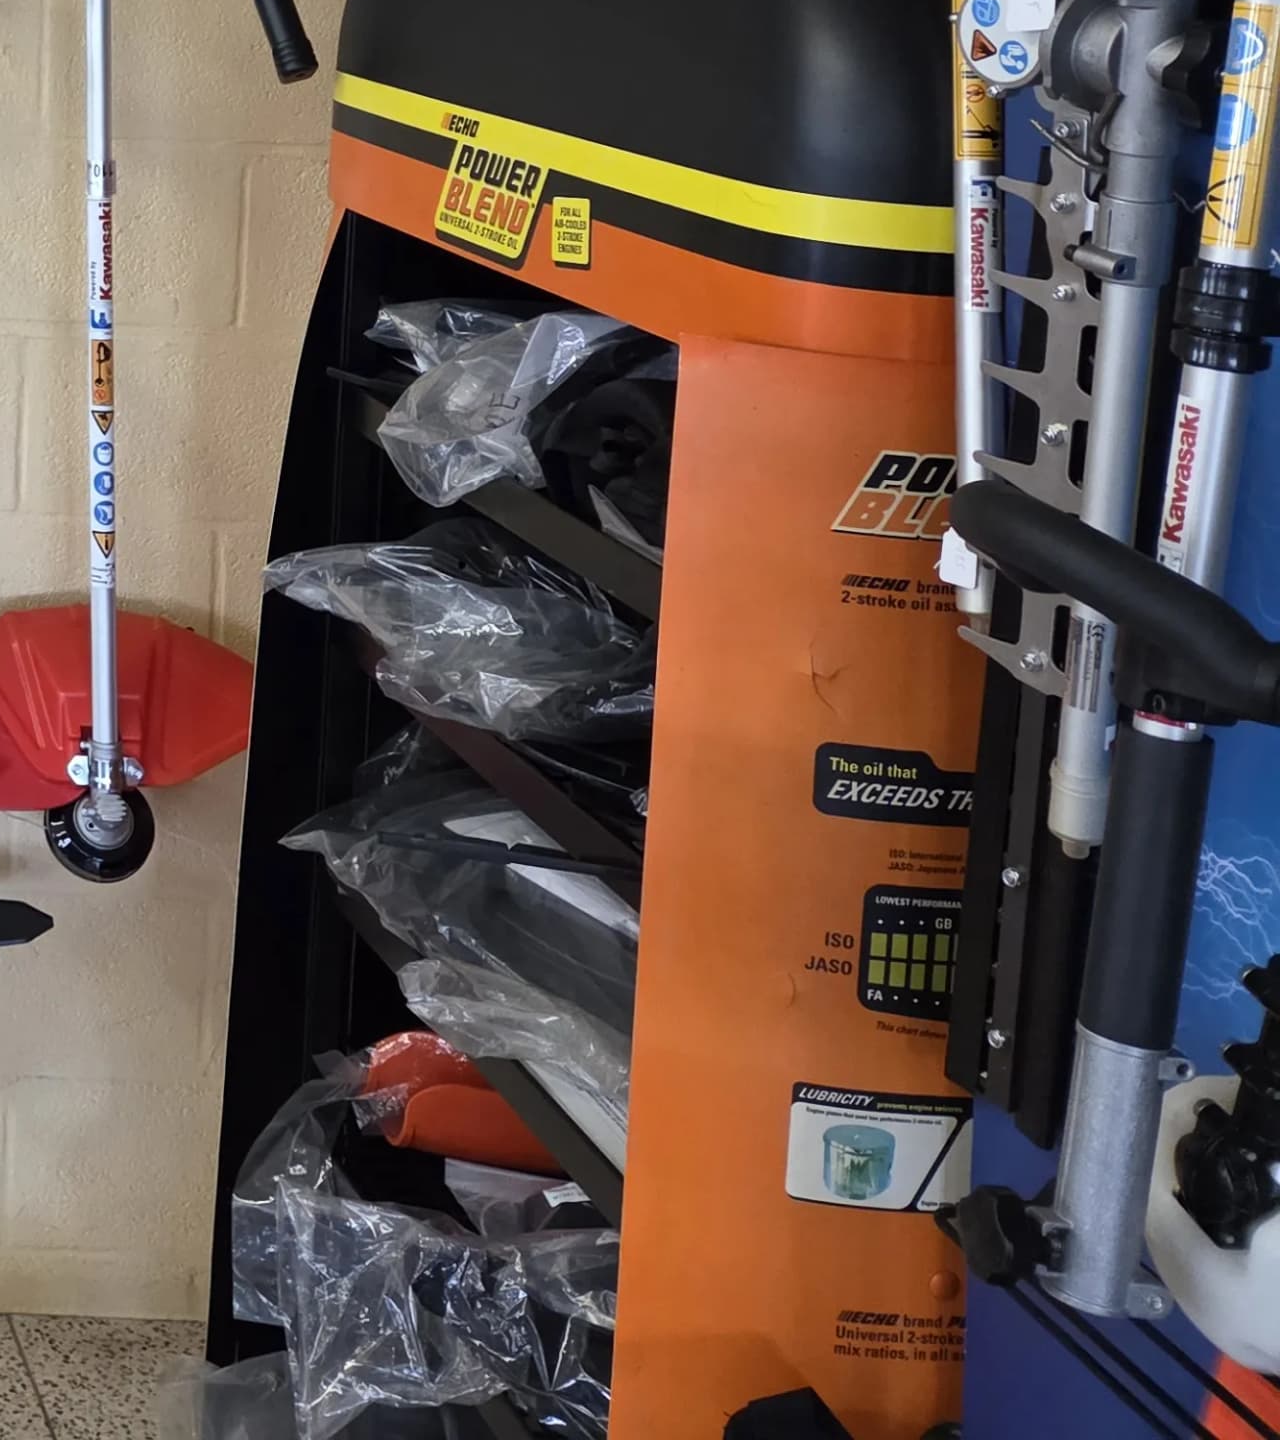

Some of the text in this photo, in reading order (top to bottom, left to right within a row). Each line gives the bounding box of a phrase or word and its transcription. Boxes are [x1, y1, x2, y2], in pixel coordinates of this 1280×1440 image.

[446, 114, 480, 138] ECHO
[454, 143, 542, 199] POWER
[444, 176, 531, 236] BLEND
[572, 208, 582, 218] ALL
[440, 212, 519, 251] UNIVERSAL 2-STROKE OIL
[98, 201, 113, 301] Kawasaki
[970, 207, 990, 308] Kawasaki
[1162, 402, 1202, 544] Kawasaki
[853, 575, 910, 592] ECHO
[841, 590, 906, 610] 2-stroke
[911, 598, 930, 611] oil
[829, 756, 918, 780] The oil that
[827, 779, 944, 809] EXCEEDS
[875, 895, 910, 907] LOWEST
[935, 917, 953, 930] GB
[824, 931, 855, 950] ISO
[804, 956, 853, 976] JASO
[867, 989, 883, 1001] FA
[799, 1087, 874, 1107] LUBRICITY
[848, 1310, 900, 1326] ECHO
[903, 1314, 943, 1329] brand
[835, 1326, 904, 1344] Universal
[834, 1342, 861, 1357] mix
[864, 1346, 909, 1361] ratios,
[914, 1348, 926, 1361] in
[930, 1348, 948, 1361] all
